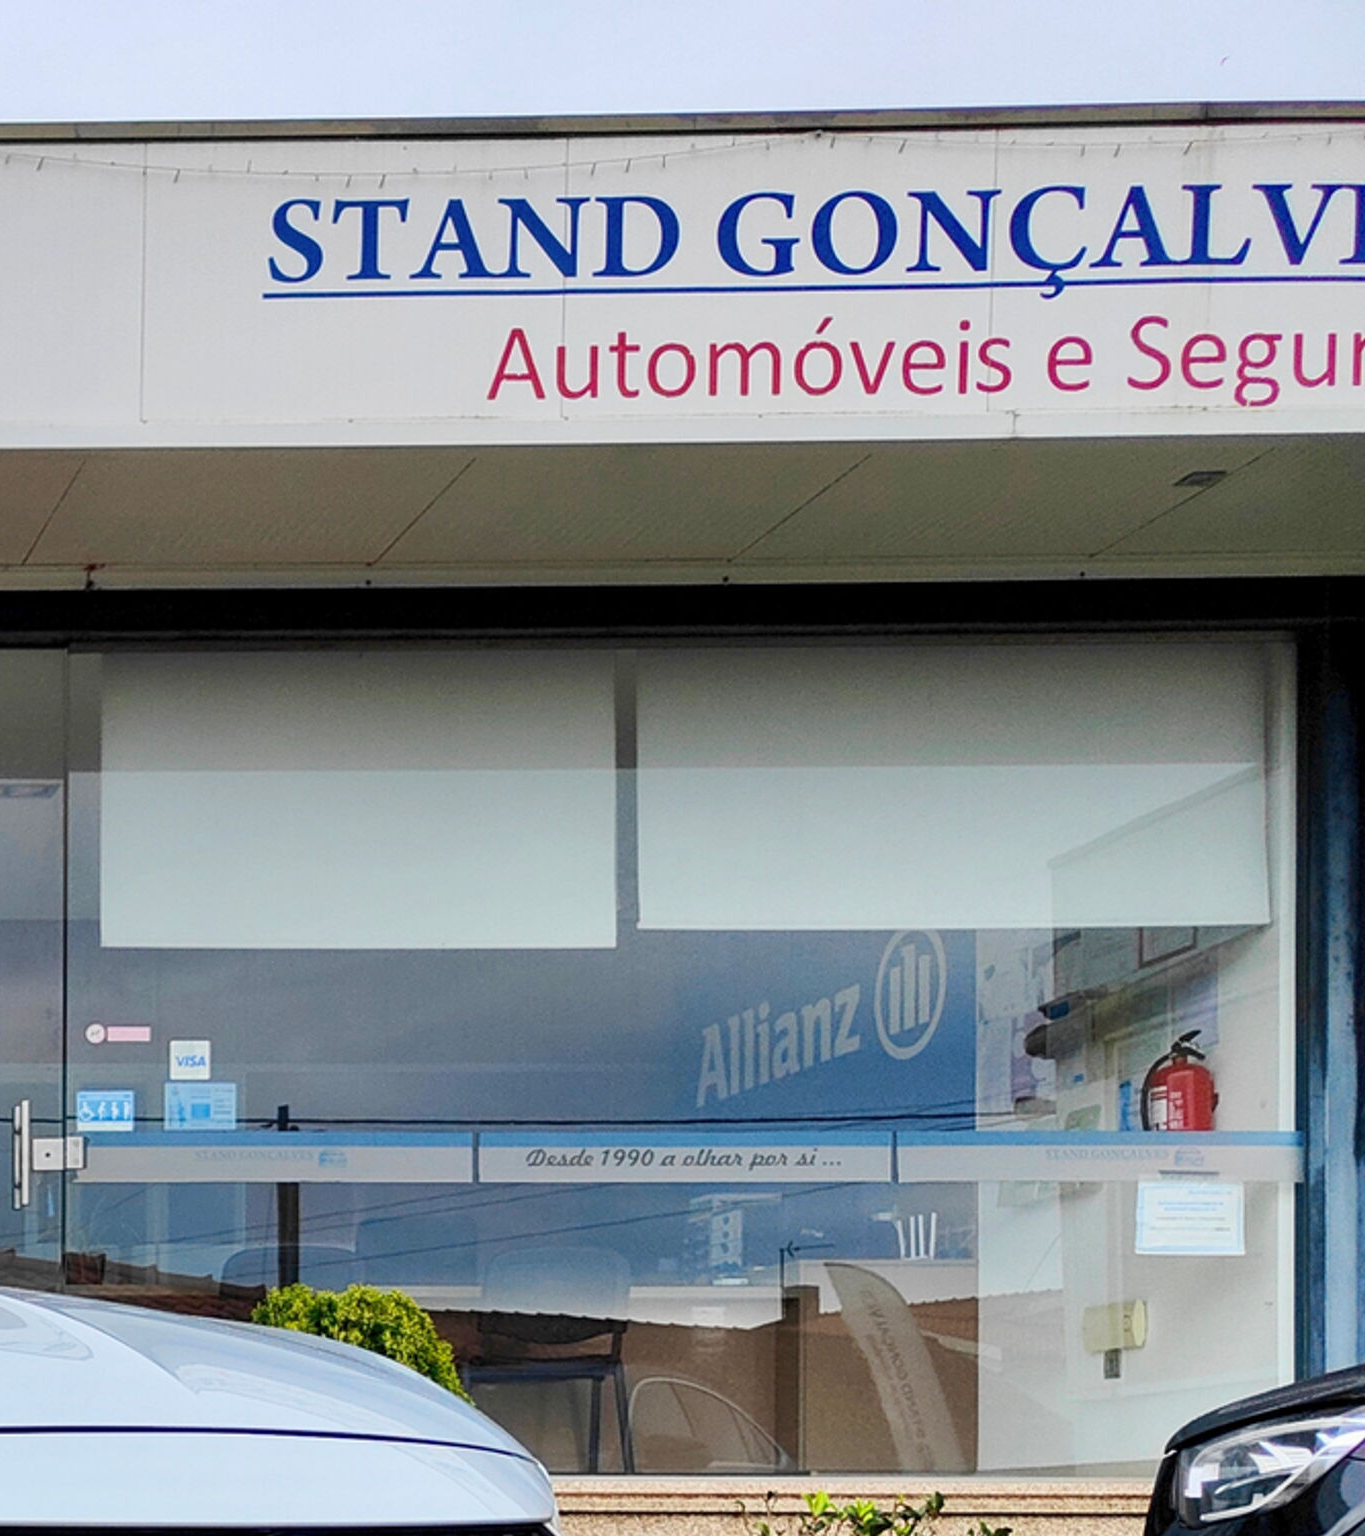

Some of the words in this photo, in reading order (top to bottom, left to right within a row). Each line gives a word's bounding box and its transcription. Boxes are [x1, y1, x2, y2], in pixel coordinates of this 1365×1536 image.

[267, 196, 681, 284] STAND
[486, 316, 1013, 402] Automóveis
[1045, 335, 1094, 392] e
[175, 1055, 206, 1067] VISA
[696, 984, 861, 1108] Allianz
[525, 1149, 594, 1167] Desde
[601, 1149, 654, 1166] 1990
[660, 1152, 676, 1167] a
[682, 1149, 742, 1167] olhar
[748, 1152, 787, 1171] por
[794, 1148, 819, 1167] si
